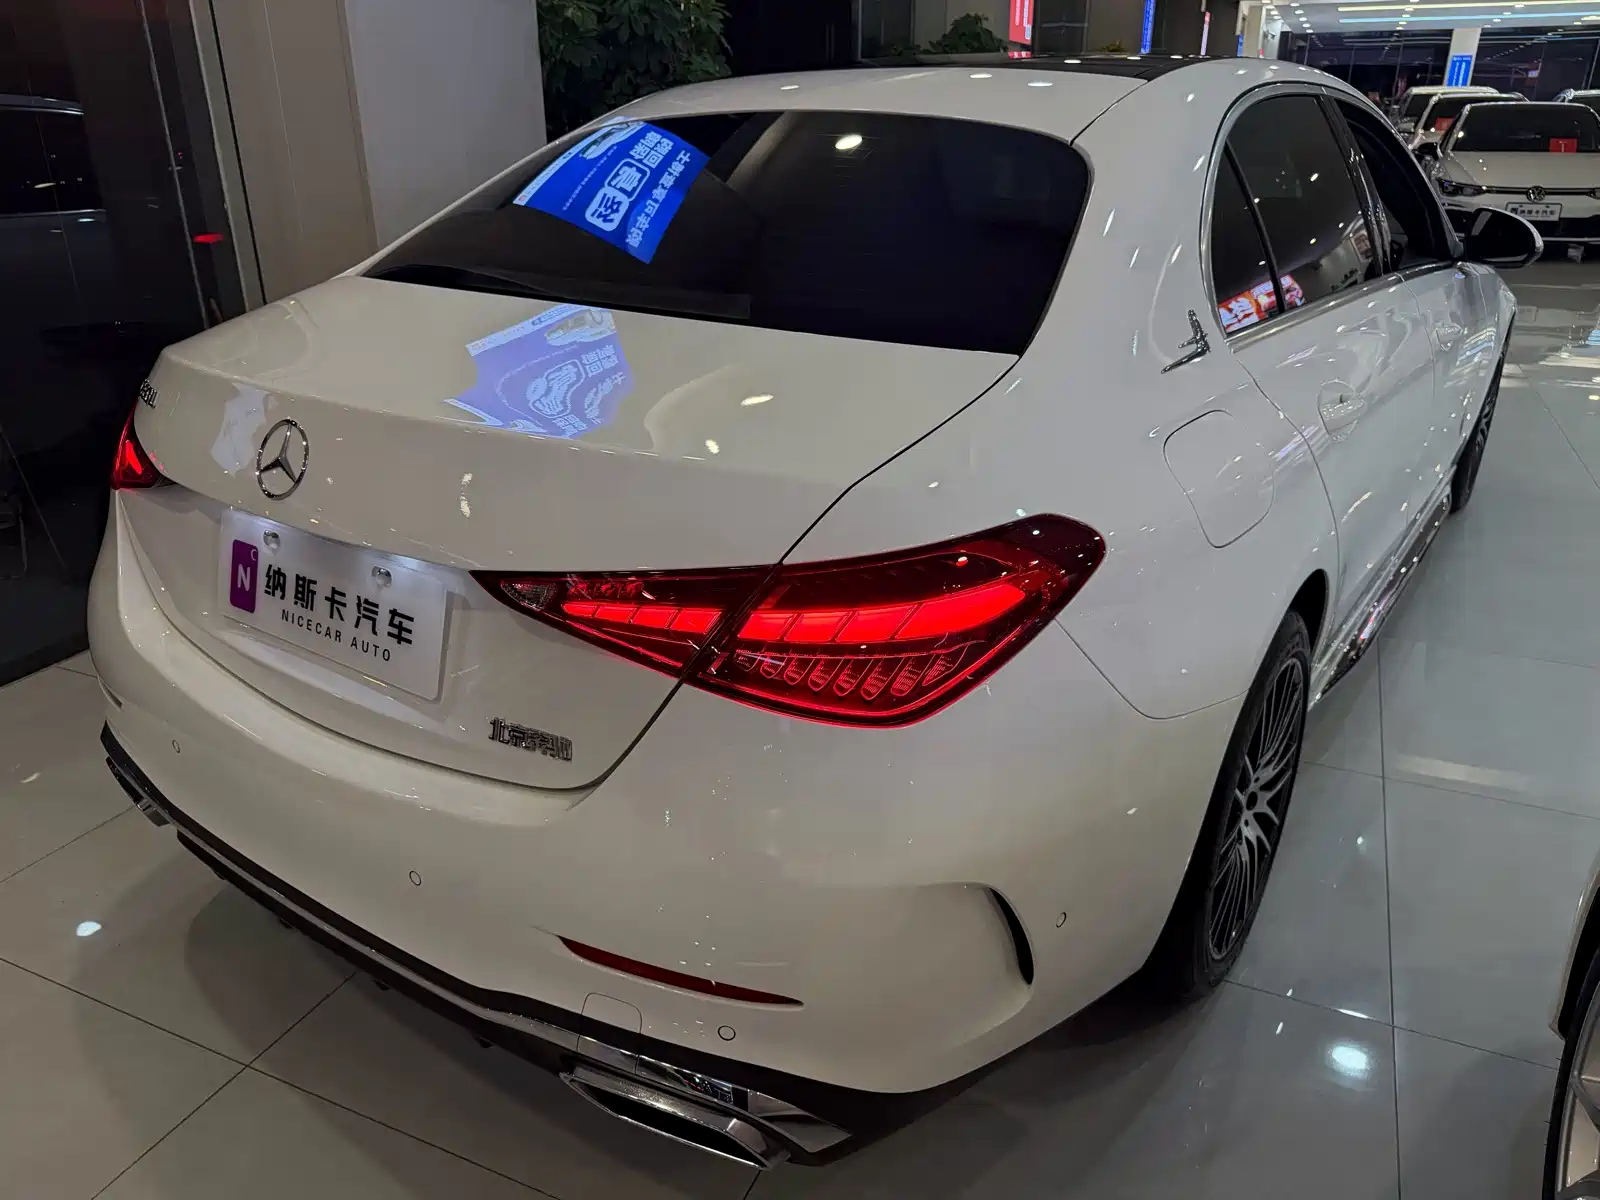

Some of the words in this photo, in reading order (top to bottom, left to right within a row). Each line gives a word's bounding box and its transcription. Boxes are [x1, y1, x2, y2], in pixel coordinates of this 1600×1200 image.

[237, 563, 251, 592] N
[264, 564, 415, 645] 纳斯卡汽车
[281, 608, 342, 643] NICECAR
[350, 636, 391, 662] AUTO
